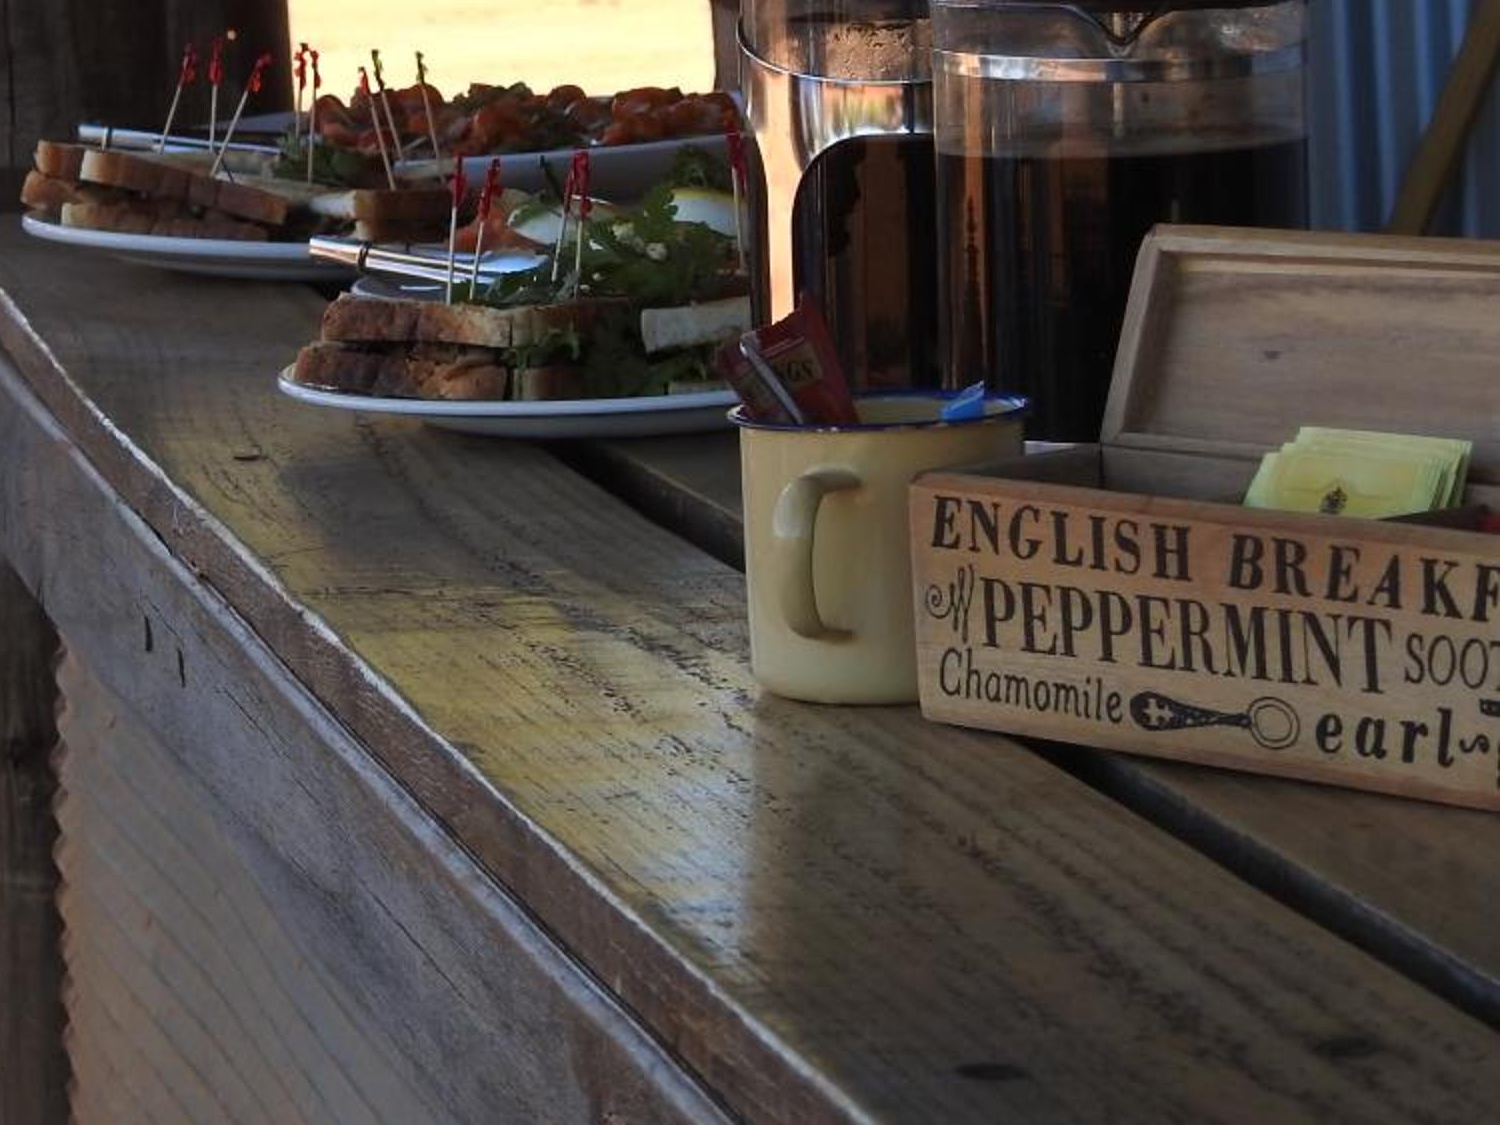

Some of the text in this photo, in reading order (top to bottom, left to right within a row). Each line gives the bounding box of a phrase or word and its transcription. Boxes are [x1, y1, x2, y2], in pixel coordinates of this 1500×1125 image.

[931, 495, 1500, 623] ENGLISH BREAKF
[981, 576, 1392, 694] PEPPERMINT
[939, 647, 1123, 724] Chamomile
[1315, 707, 1455, 768] earl
